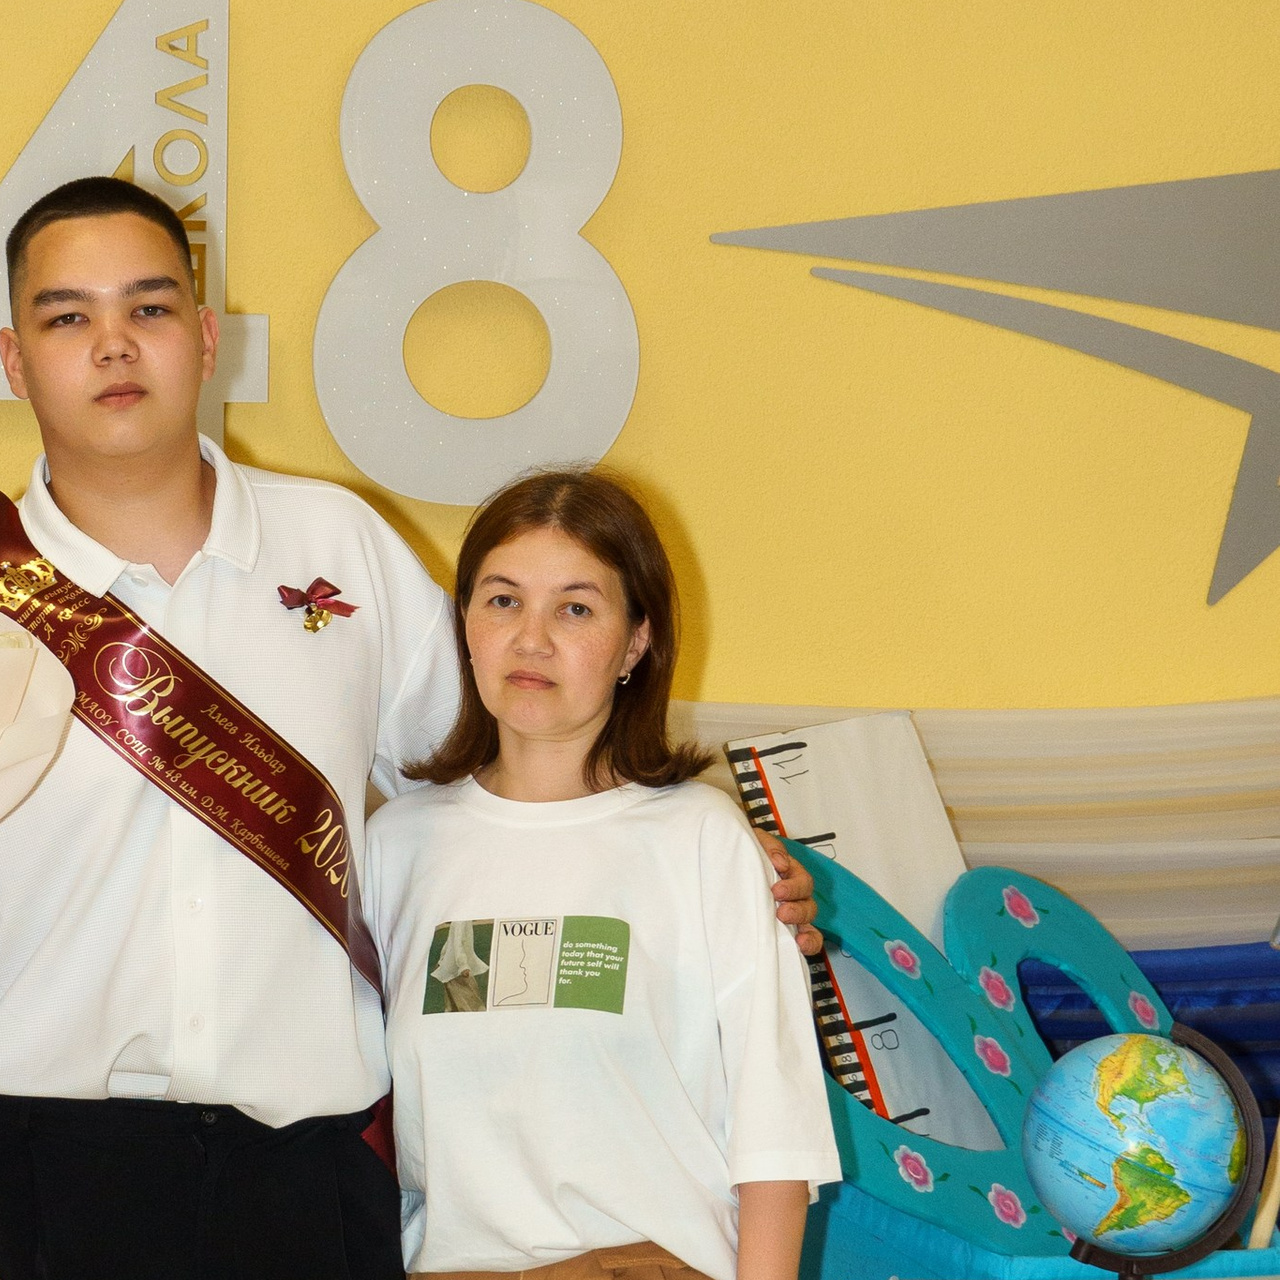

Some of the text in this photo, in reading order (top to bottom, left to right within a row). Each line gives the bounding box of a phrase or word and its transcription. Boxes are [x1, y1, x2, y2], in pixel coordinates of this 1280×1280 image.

[44, 581, 75, 601] выпус
[57, 587, 84, 604] школ
[93, 640, 298, 825] Выпускник
[200, 703, 288, 777] Алеев Ильдар
[772, 753, 810, 785] 11
[76, 690, 119, 726] МАОУ
[115, 728, 152, 758] СОШ
[147, 755, 167, 772] №
[165, 769, 182, 783] 48
[179, 781, 198, 799] им.
[230, 818, 290, 871] Карбышева
[502, 922, 554, 937] VOGUE
[561, 950, 624, 962] today that your
[575, 942, 618, 953] something
[870, 1028, 900, 1050] 8
[841, 1054, 852, 1063] 8
